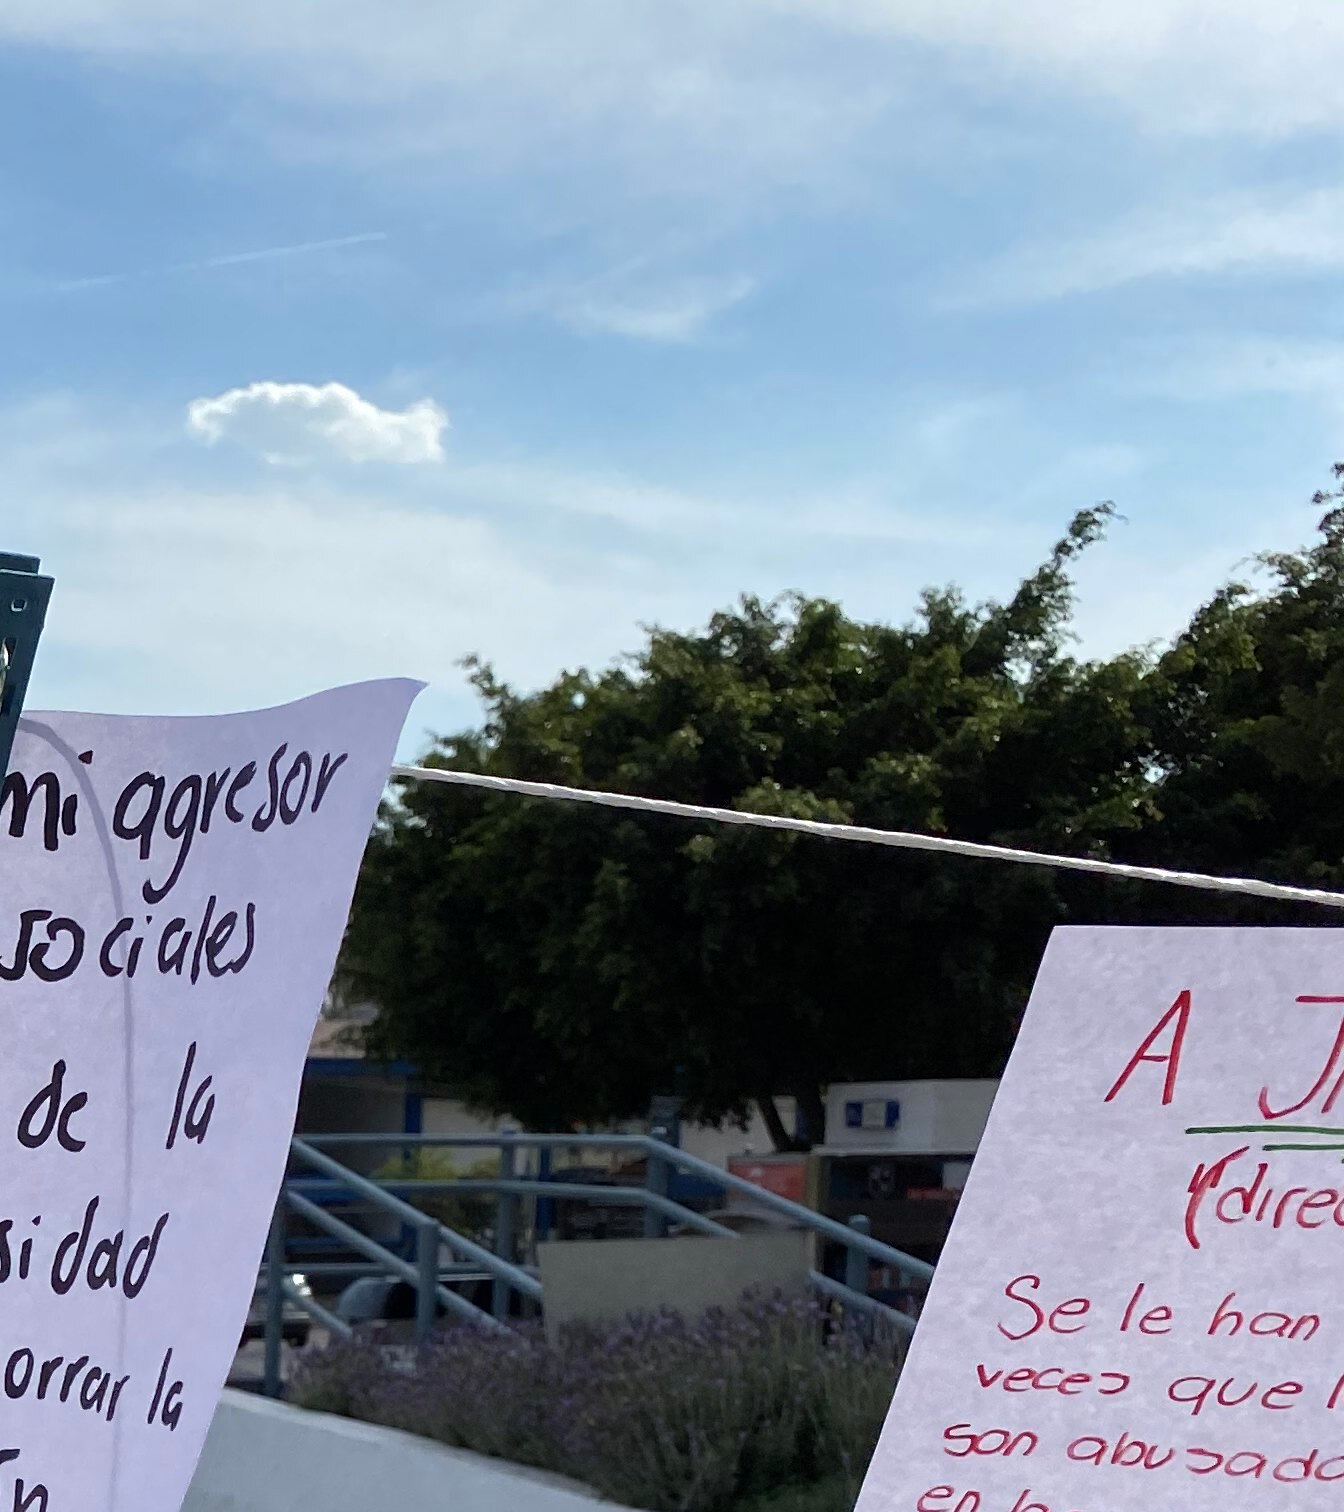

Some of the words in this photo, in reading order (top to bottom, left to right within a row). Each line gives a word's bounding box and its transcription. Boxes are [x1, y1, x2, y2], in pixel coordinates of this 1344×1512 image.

[112, 742, 350, 905] agresor
[1104, 989, 1192, 1105] A
[16, 1058, 89, 1153] de
[165, 1040, 216, 1151] la
[997, 1274, 1091, 1341] Se
[1120, 1281, 1173, 1336] le
[1207, 1292, 1321, 1342] han
[147, 1346, 184, 1431] la
[976, 1363, 1131, 1396] veces
[1167, 1375, 1304, 1416] que
[942, 1423, 1040, 1458] son
